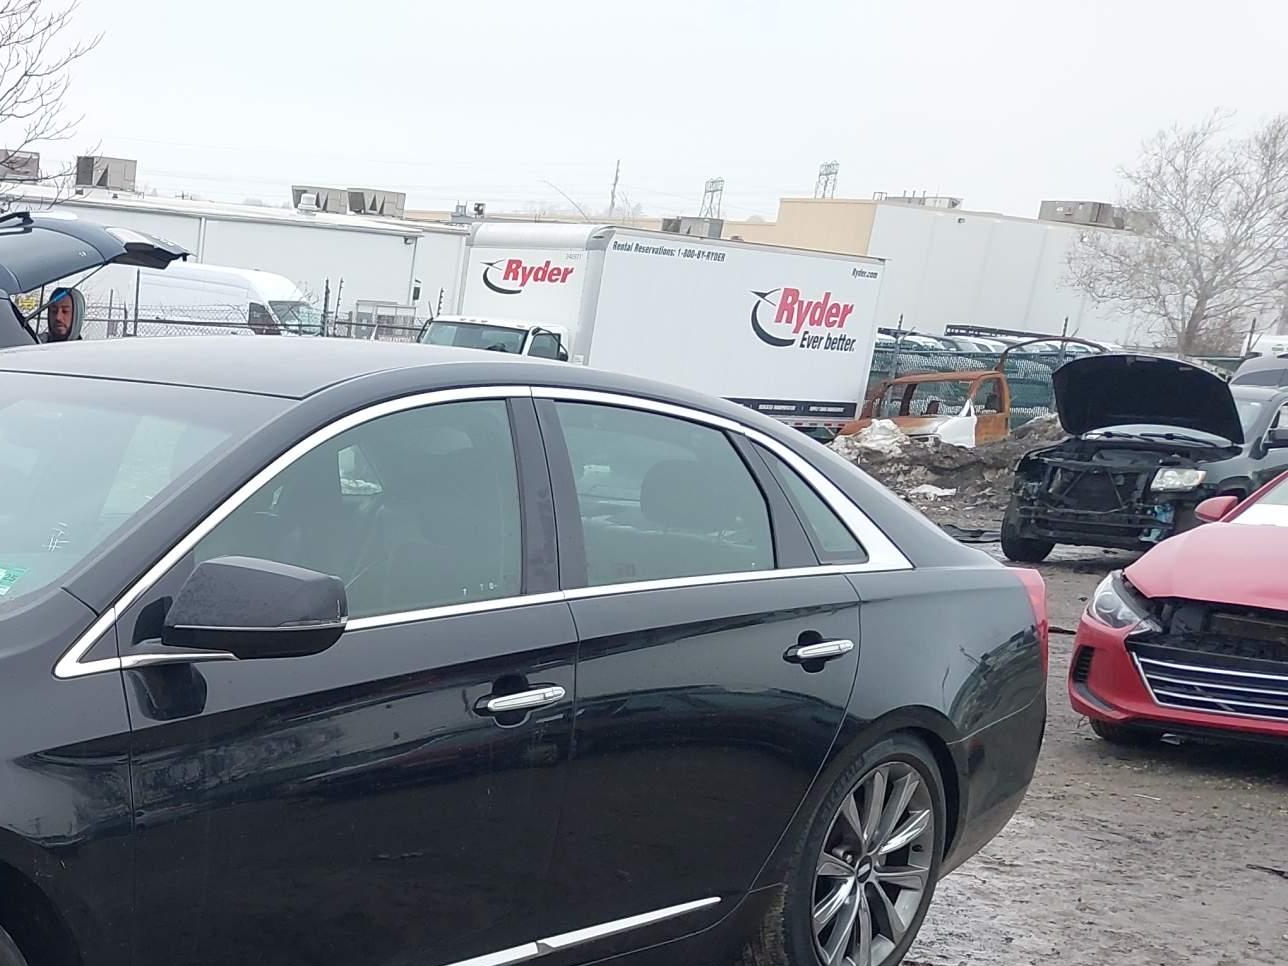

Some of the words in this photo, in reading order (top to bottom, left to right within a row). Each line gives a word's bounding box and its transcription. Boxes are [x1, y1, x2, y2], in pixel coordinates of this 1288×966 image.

[612, 240, 633, 252] Rental
[634, 243, 675, 257] Reservations:
[502, 258, 574, 288] Ryder
[851, 267, 878, 279] Ryder.com
[774, 287, 854, 334] Ryder
[799, 330, 824, 351] Ever
[823, 332, 857, 352] better.
